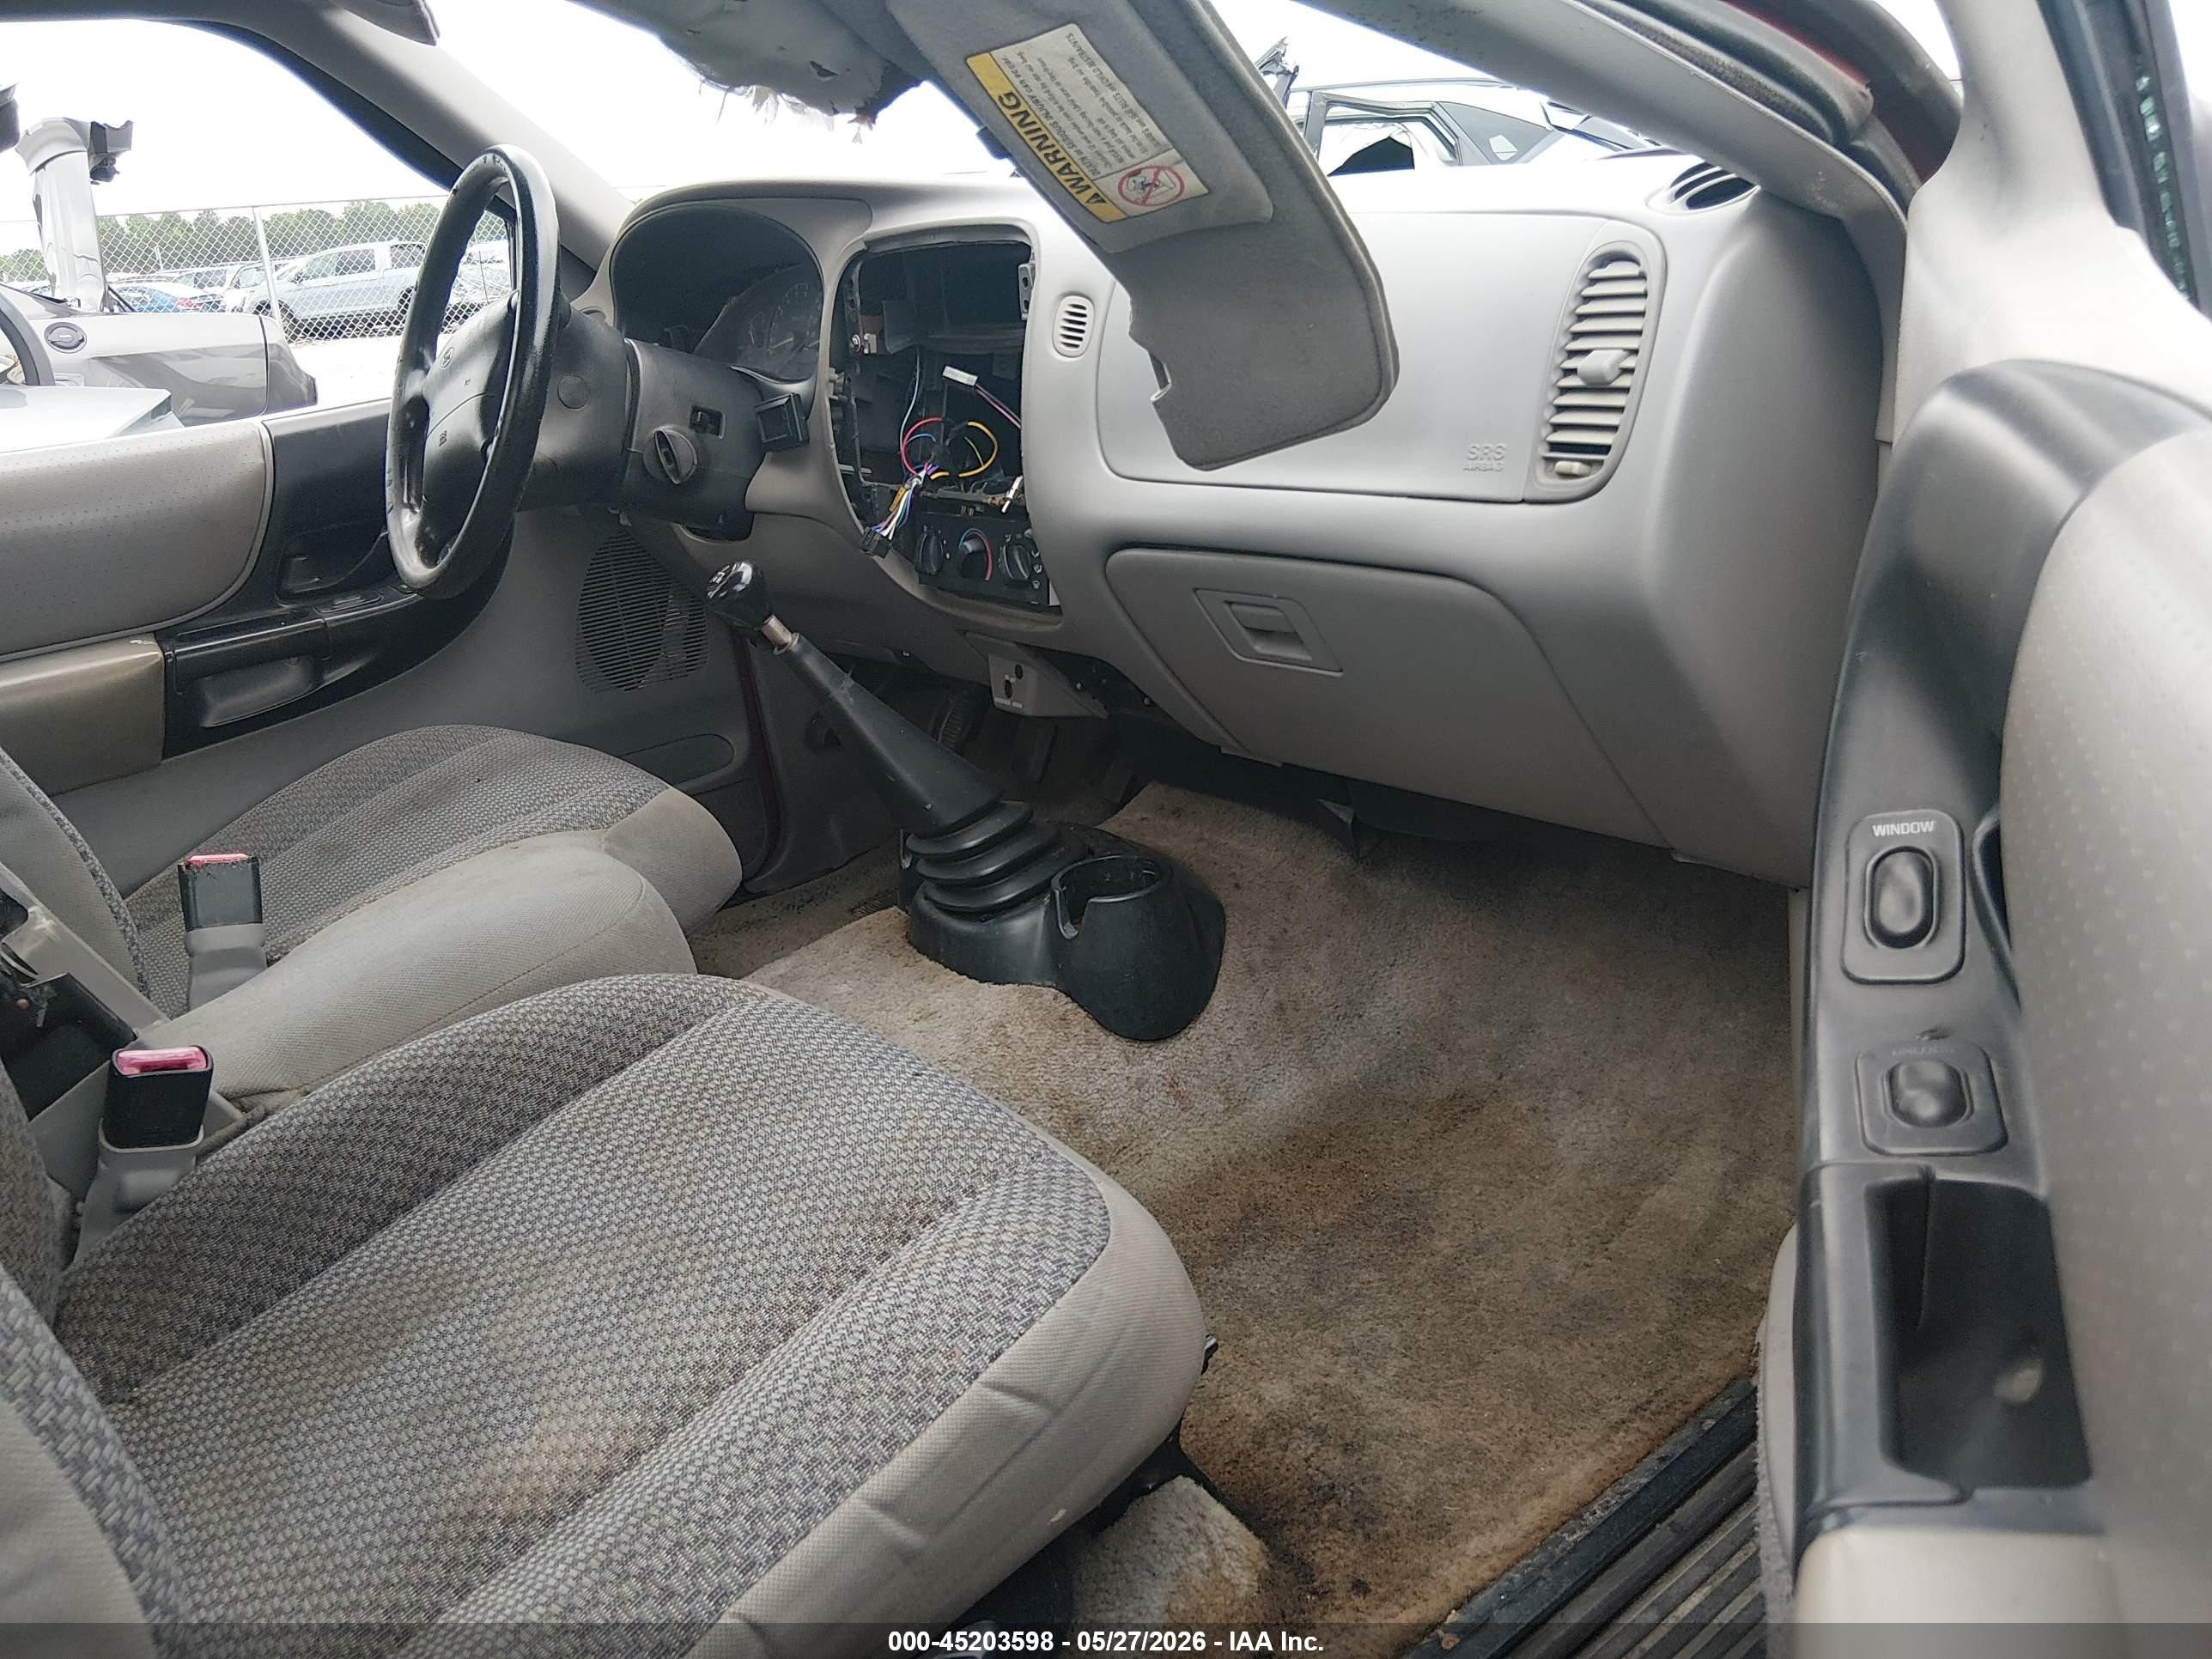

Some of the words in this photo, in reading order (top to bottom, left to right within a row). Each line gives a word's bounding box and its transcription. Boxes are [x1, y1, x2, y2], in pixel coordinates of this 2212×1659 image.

[1017, 78, 1035, 93] can
[1025, 93, 1055, 121] INJURY
[997, 91, 1095, 195] WARNING
[1048, 120, 1078, 149] SERIOUS
[1467, 442, 1508, 461] SRS
[1872, 820, 1936, 837] WINDOW
